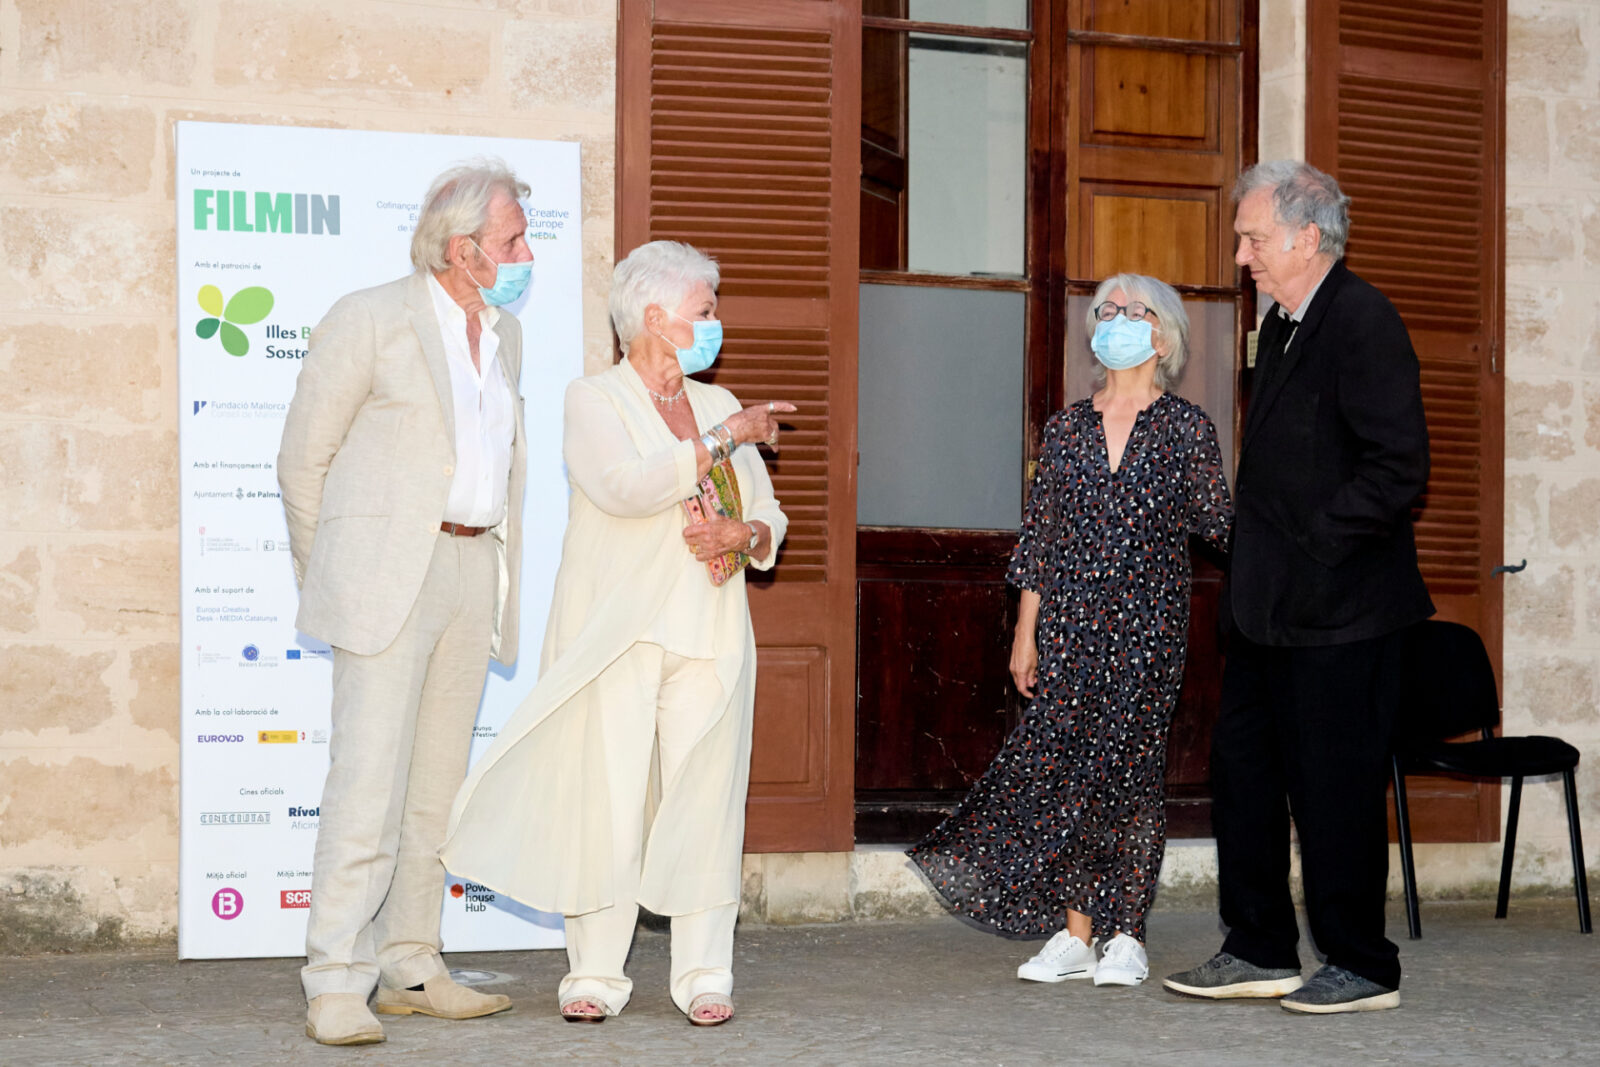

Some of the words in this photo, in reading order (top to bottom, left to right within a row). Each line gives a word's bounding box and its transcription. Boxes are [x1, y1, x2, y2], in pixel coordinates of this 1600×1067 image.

[202, 169, 230, 177] projecte
[193, 188, 340, 235] FILMIN
[528, 208, 569, 218] Creative
[398, 224, 408, 232] de
[529, 218, 564, 229] Europe
[530, 232, 557, 240] MEDIA
[266, 325, 297, 339] Illes
[211, 400, 248, 410] Fundació
[250, 401, 286, 411] Mallorca
[193, 461, 209, 469] Amb
[194, 489, 234, 499] Ajuntament
[258, 491, 281, 499] Palma
[222, 587, 243, 595] suport
[246, 586, 254, 594] de
[196, 605, 220, 614] Europa
[220, 614, 243, 622] MEDIA
[214, 708, 220, 716] la
[269, 707, 278, 715] de
[240, 788, 258, 796] Cines
[260, 787, 284, 795] oficials
[226, 871, 247, 879] oficial
[465, 883, 496, 892] Pow
[465, 892, 496, 903] house
[465, 902, 487, 912] Hub
